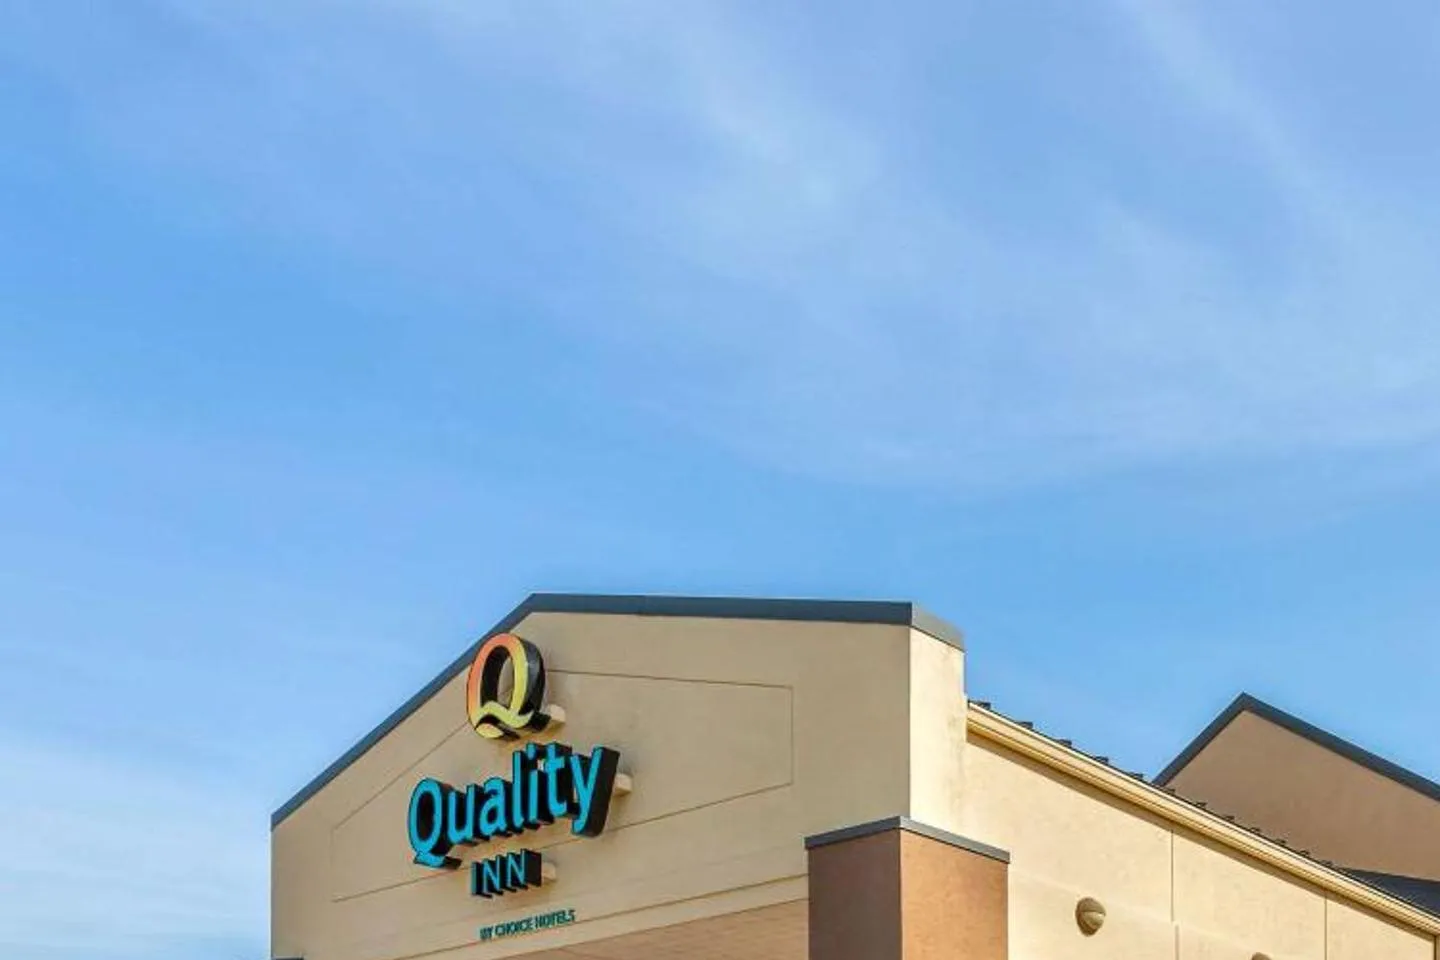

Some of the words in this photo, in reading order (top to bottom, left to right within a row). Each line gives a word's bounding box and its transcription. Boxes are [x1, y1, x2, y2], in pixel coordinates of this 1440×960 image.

[466, 633, 541, 738] Q
[408, 742, 612, 869] Quality
[471, 849, 534, 896] INN
[495, 915, 534, 936] CHOICE
[535, 909, 576, 929] HOTELS
